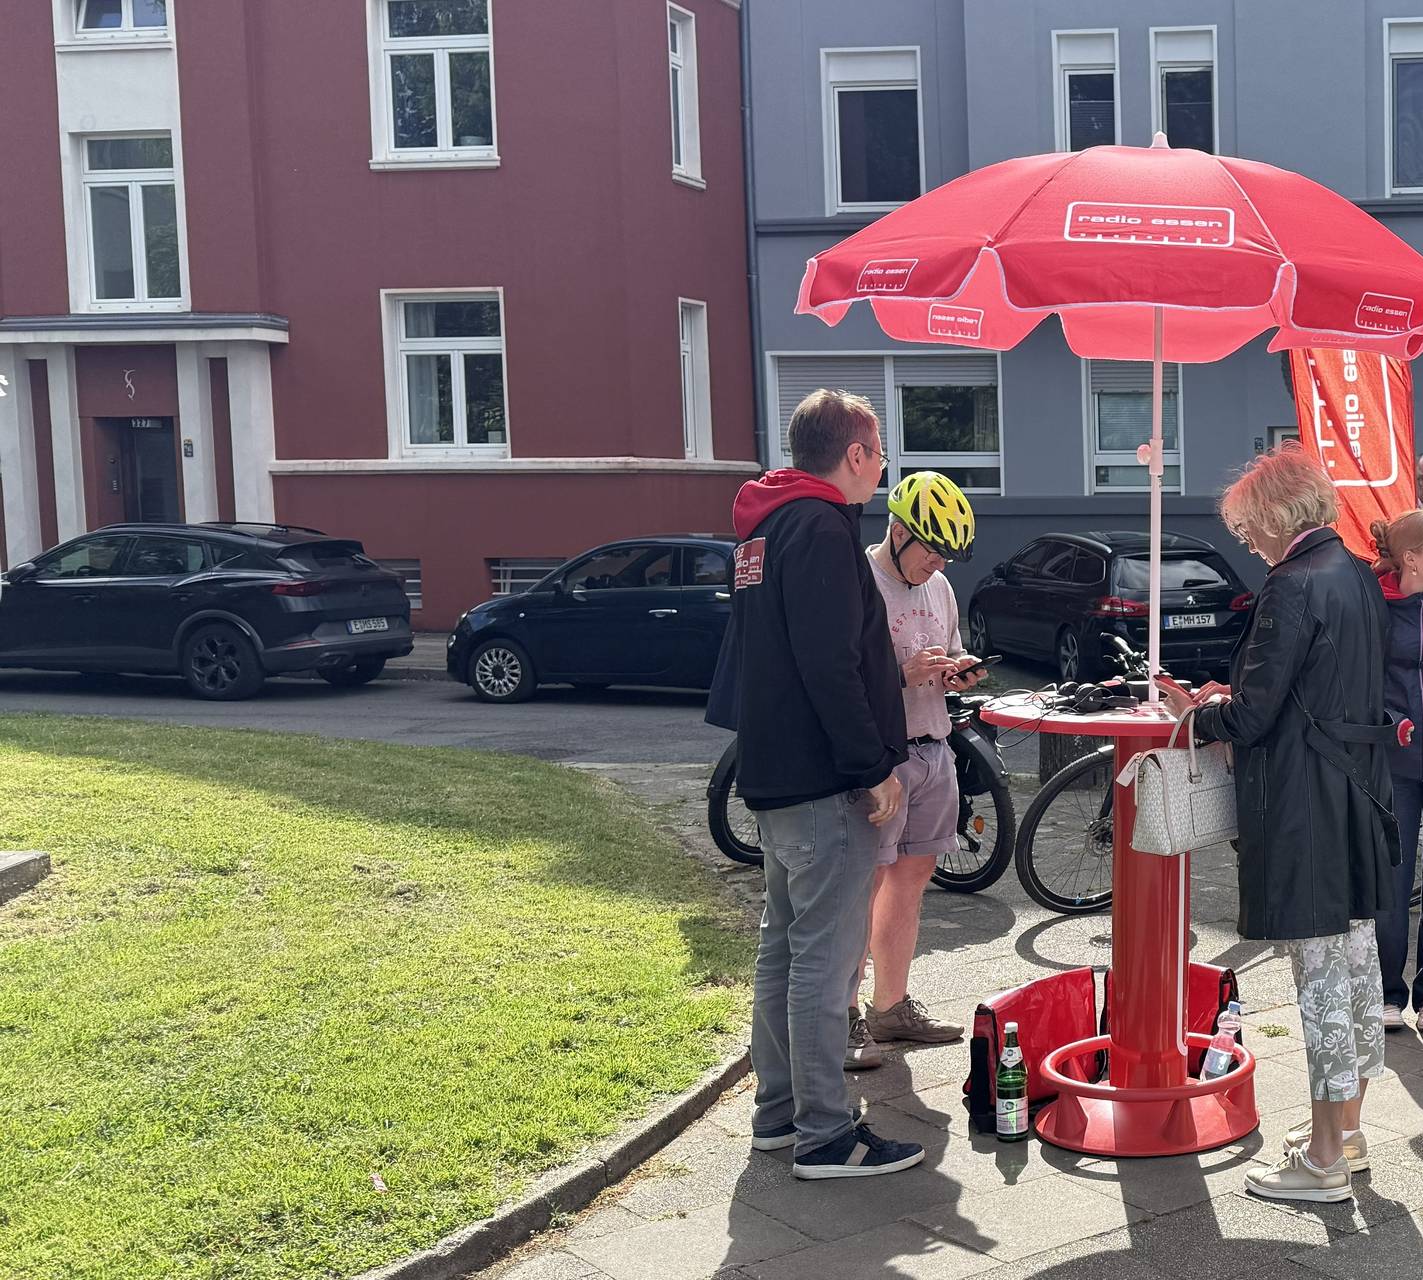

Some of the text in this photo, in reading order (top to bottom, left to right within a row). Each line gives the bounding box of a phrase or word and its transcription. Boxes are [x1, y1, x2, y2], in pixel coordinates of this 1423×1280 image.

[1078, 215, 1223, 228] radio essen
[1361, 304, 1408, 317] radio essen
